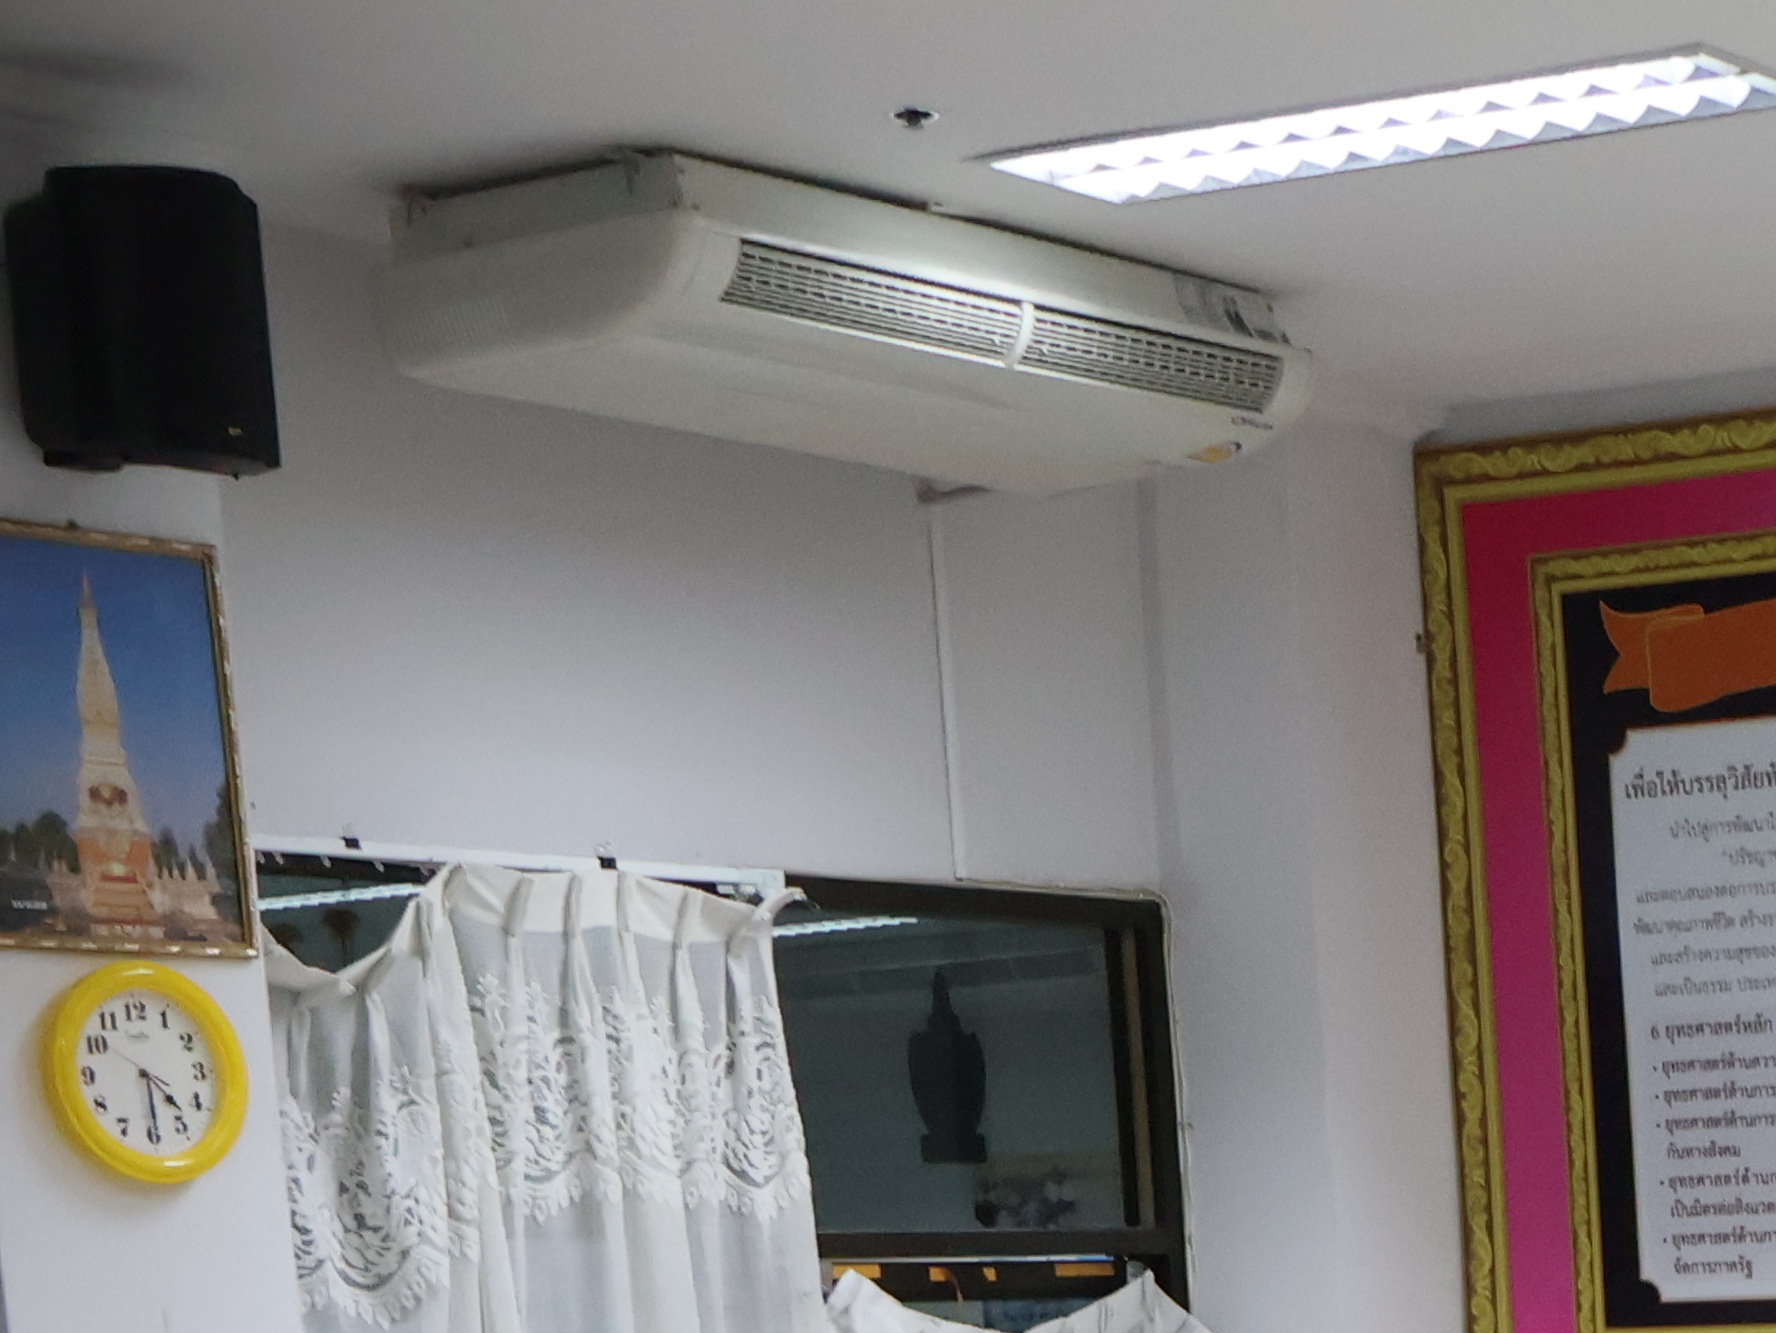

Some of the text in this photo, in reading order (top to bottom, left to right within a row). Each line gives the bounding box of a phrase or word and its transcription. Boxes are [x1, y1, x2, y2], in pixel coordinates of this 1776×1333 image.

[98, 1011, 118, 1031] 11
[124, 1001, 148, 1022] 12
[160, 1009, 170, 1030] 1
[86, 1034, 109, 1055] 10
[179, 1032, 193, 1052] 2
[81, 1066, 95, 1087] 9
[191, 1061, 206, 1082] 3
[192, 1091, 203, 1112] 4
[116, 1117, 130, 1137] 7
[174, 1115, 189, 1136] 5
